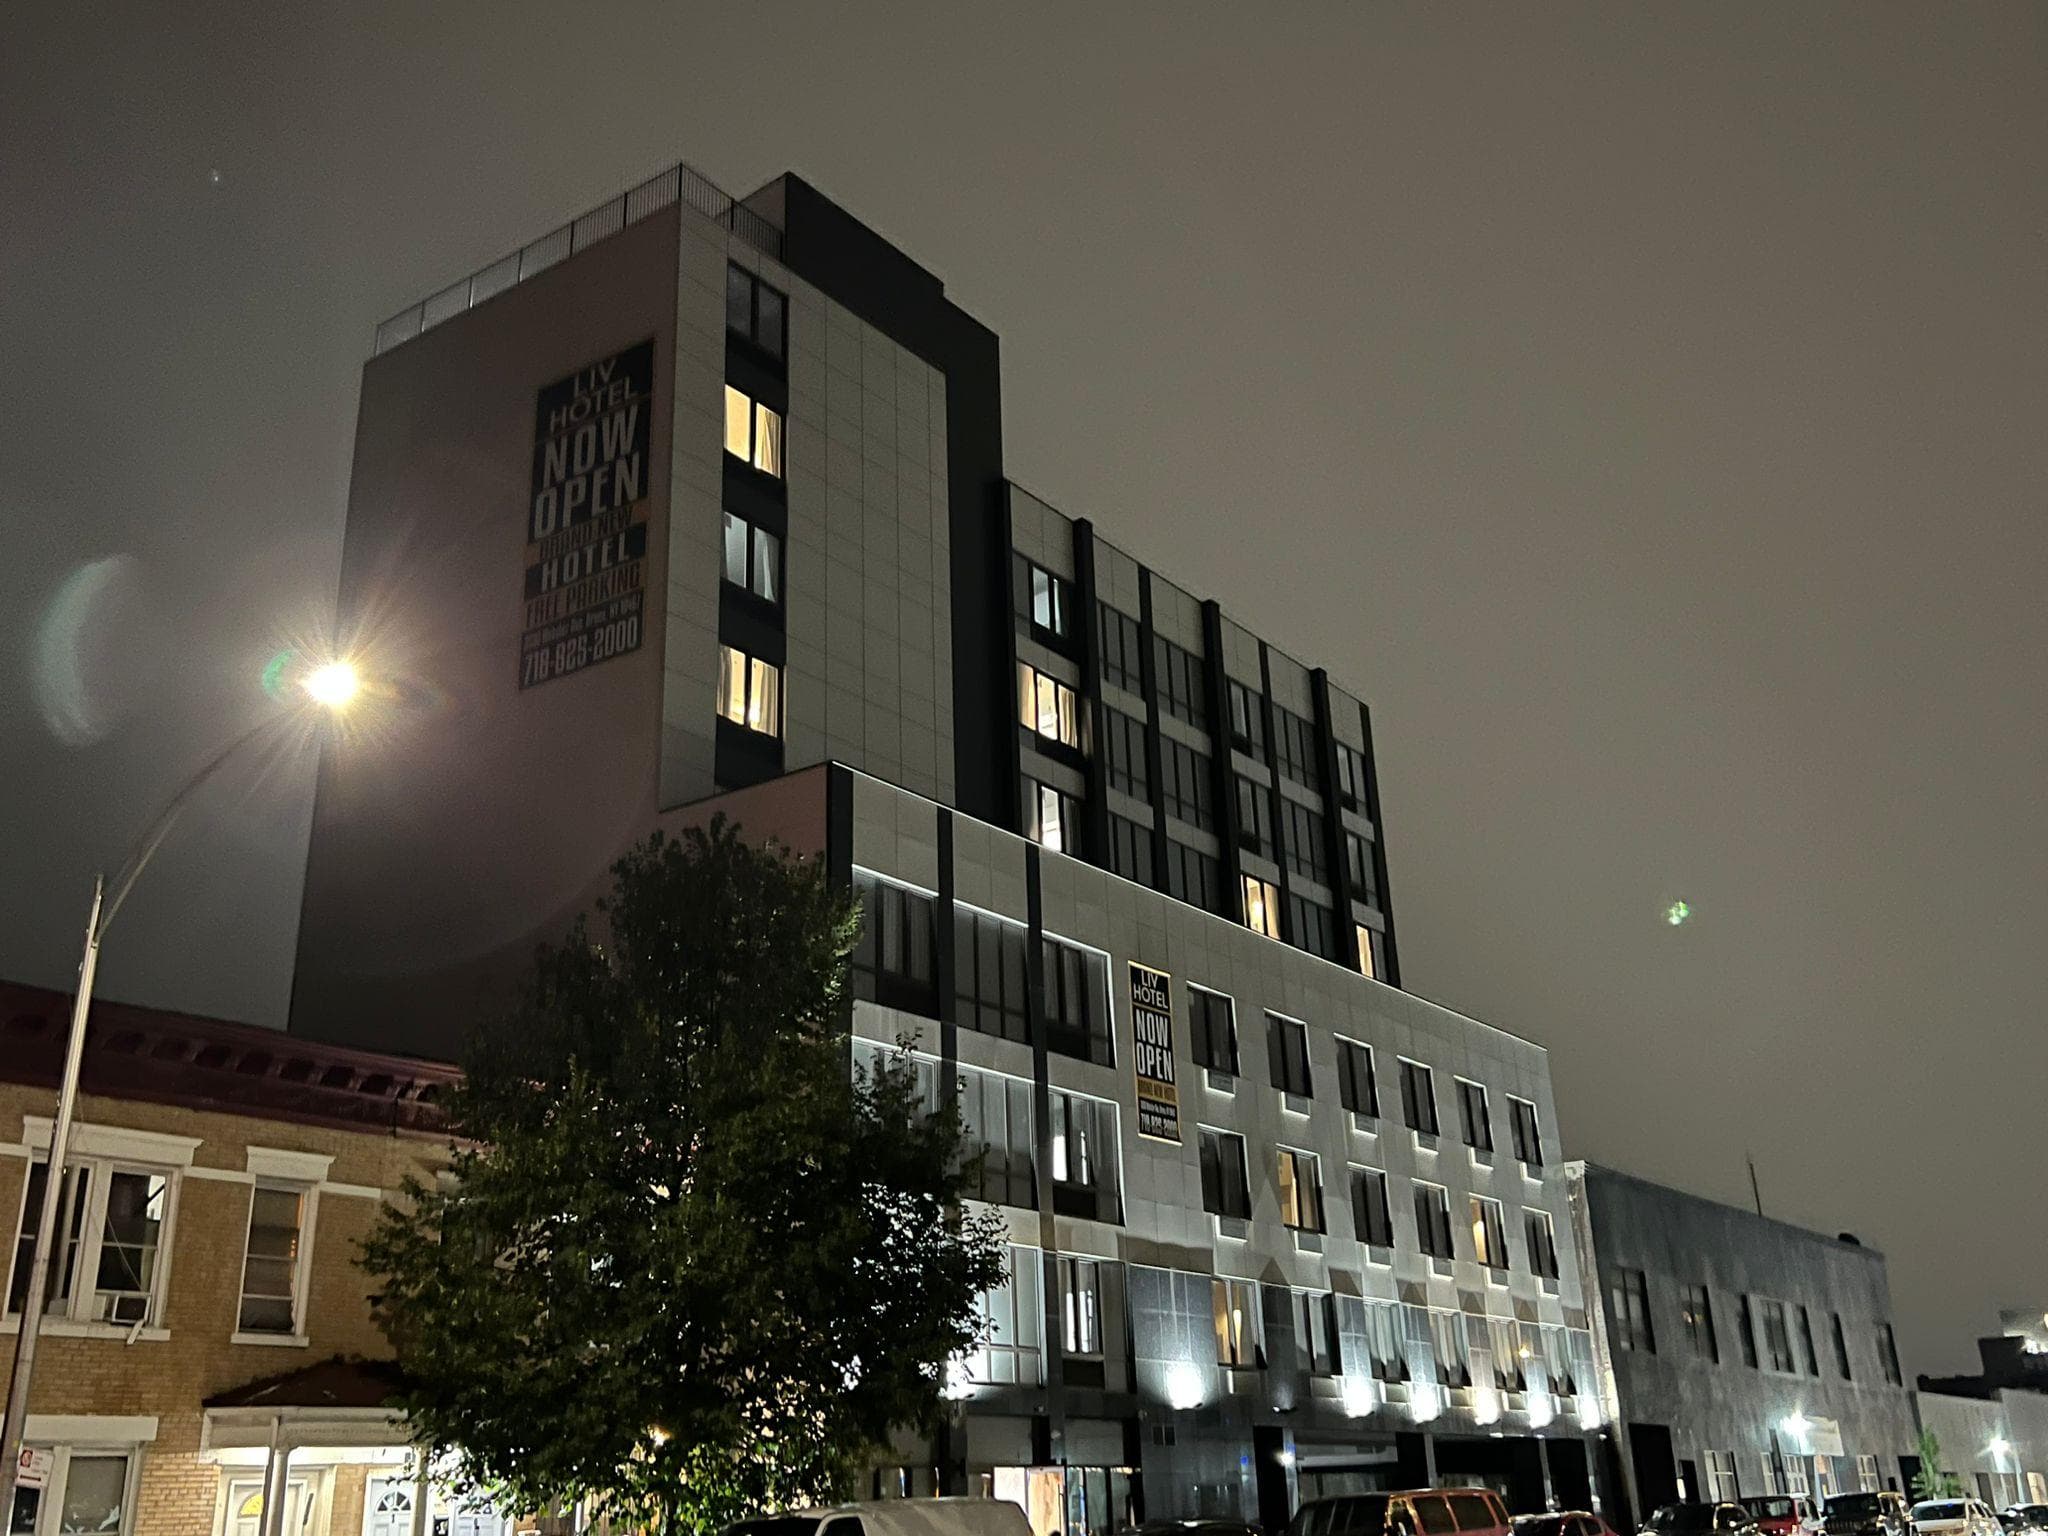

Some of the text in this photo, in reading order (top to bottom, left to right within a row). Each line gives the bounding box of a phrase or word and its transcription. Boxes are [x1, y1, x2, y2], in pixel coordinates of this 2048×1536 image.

[573, 358, 617, 398] LIV
[549, 375, 638, 431] HOTEL
[543, 402, 638, 489] NOW
[534, 449, 639, 540] OPEN
[541, 532, 630, 592] HOTEL
[1133, 983, 1169, 1010] HOTEL
[1141, 969, 1159, 989] LIV
[1135, 1008, 1169, 1048] NOW
[1136, 1043, 1174, 1083] OPEN
